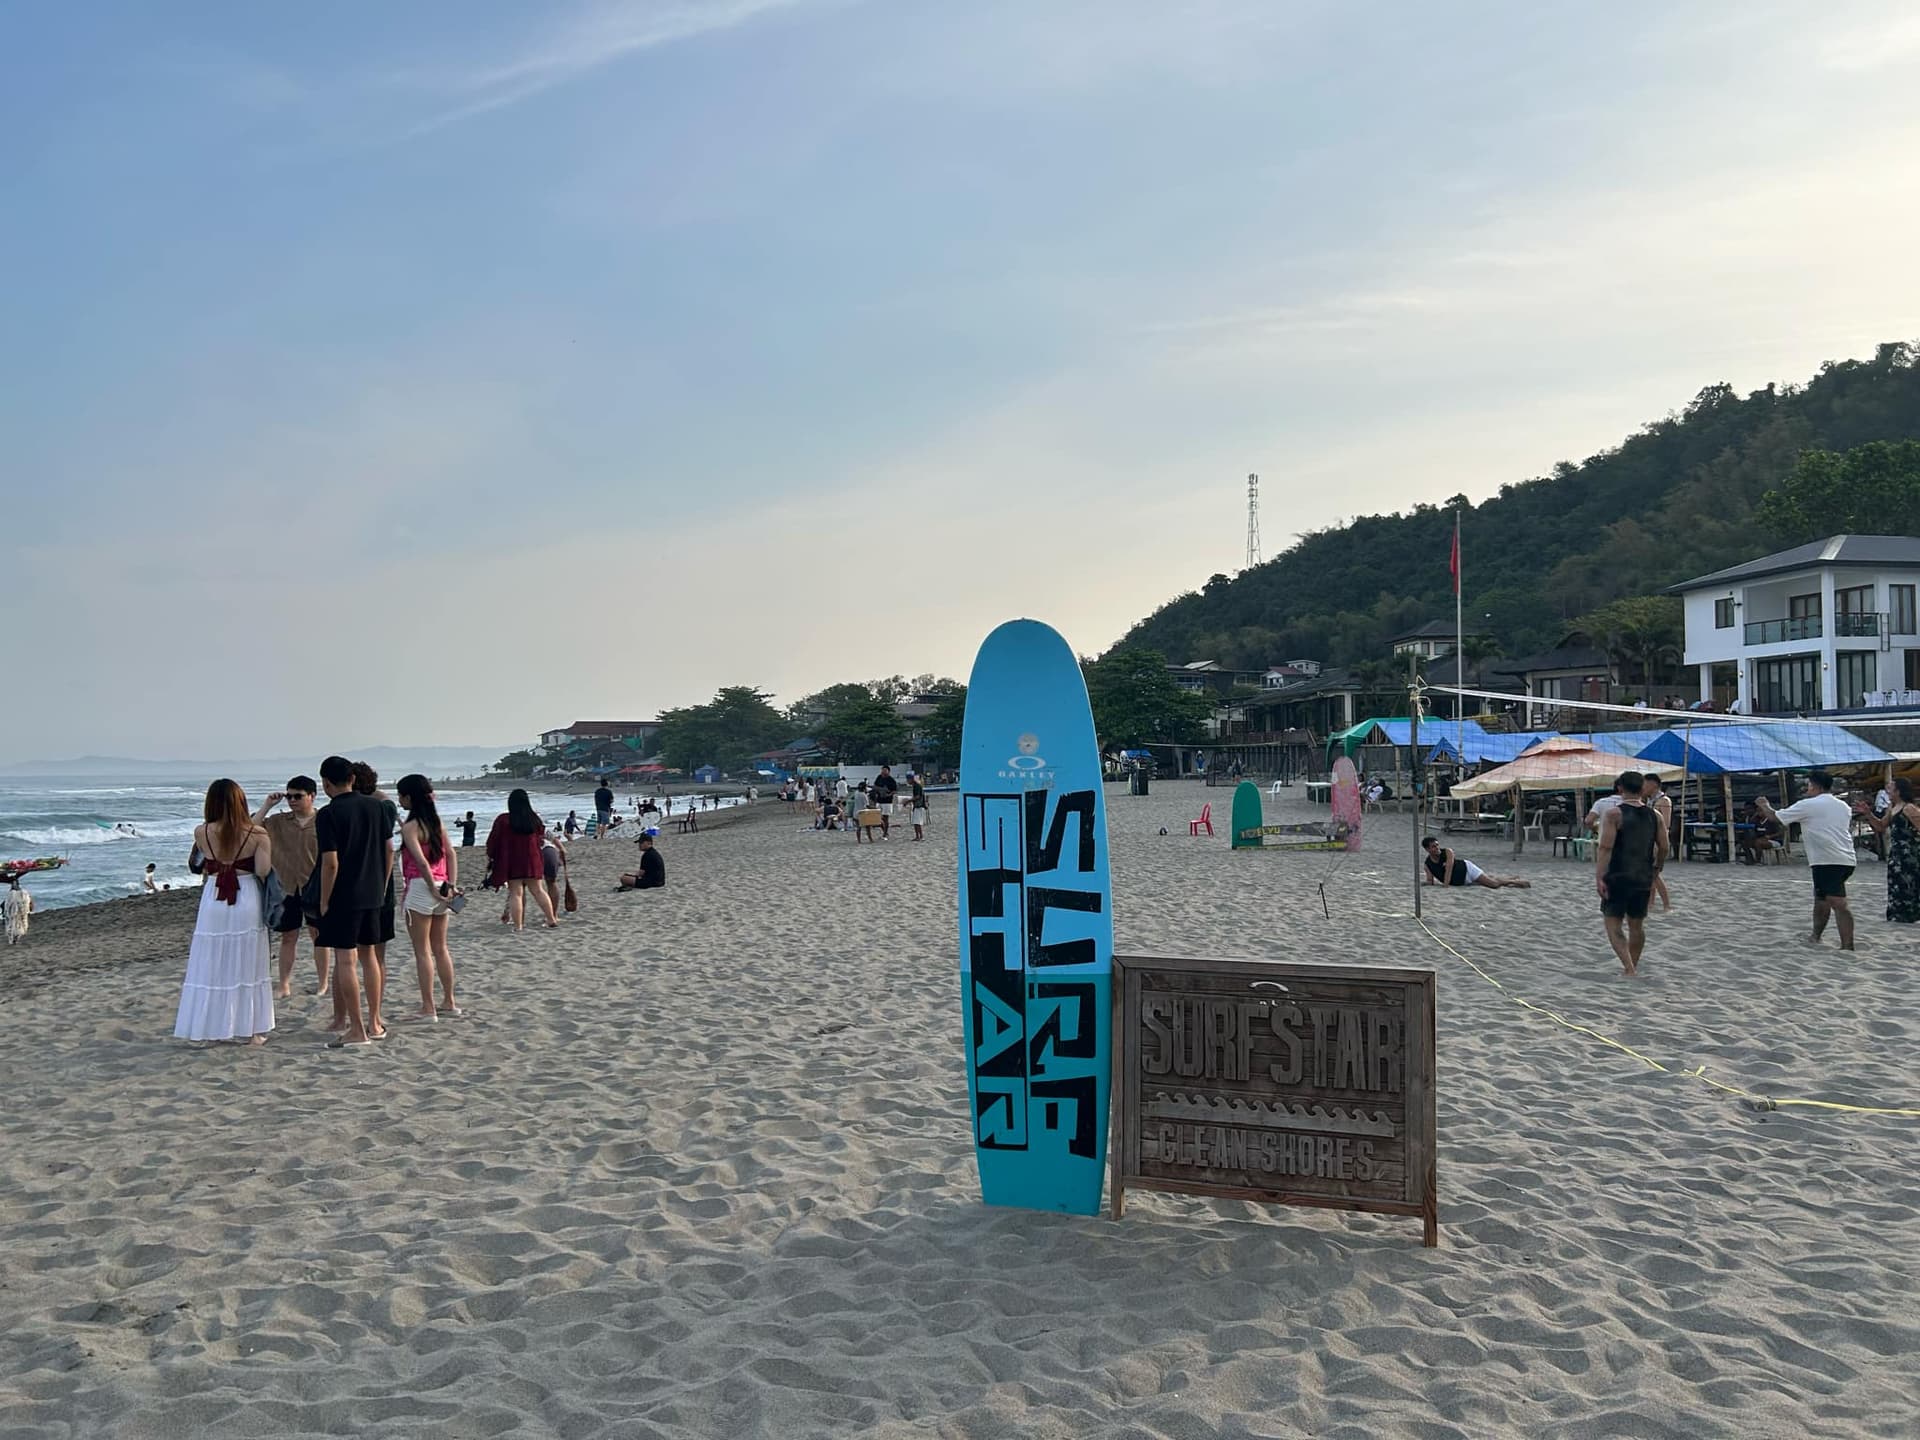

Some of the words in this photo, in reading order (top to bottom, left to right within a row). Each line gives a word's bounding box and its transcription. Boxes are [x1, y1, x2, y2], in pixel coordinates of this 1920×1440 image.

[964, 794, 1028, 1150] STAR
[1024, 789, 1102, 1160] SURF
[1158, 1123, 1248, 1171] CLEAN
[1260, 1131, 1376, 1183] SHORES
